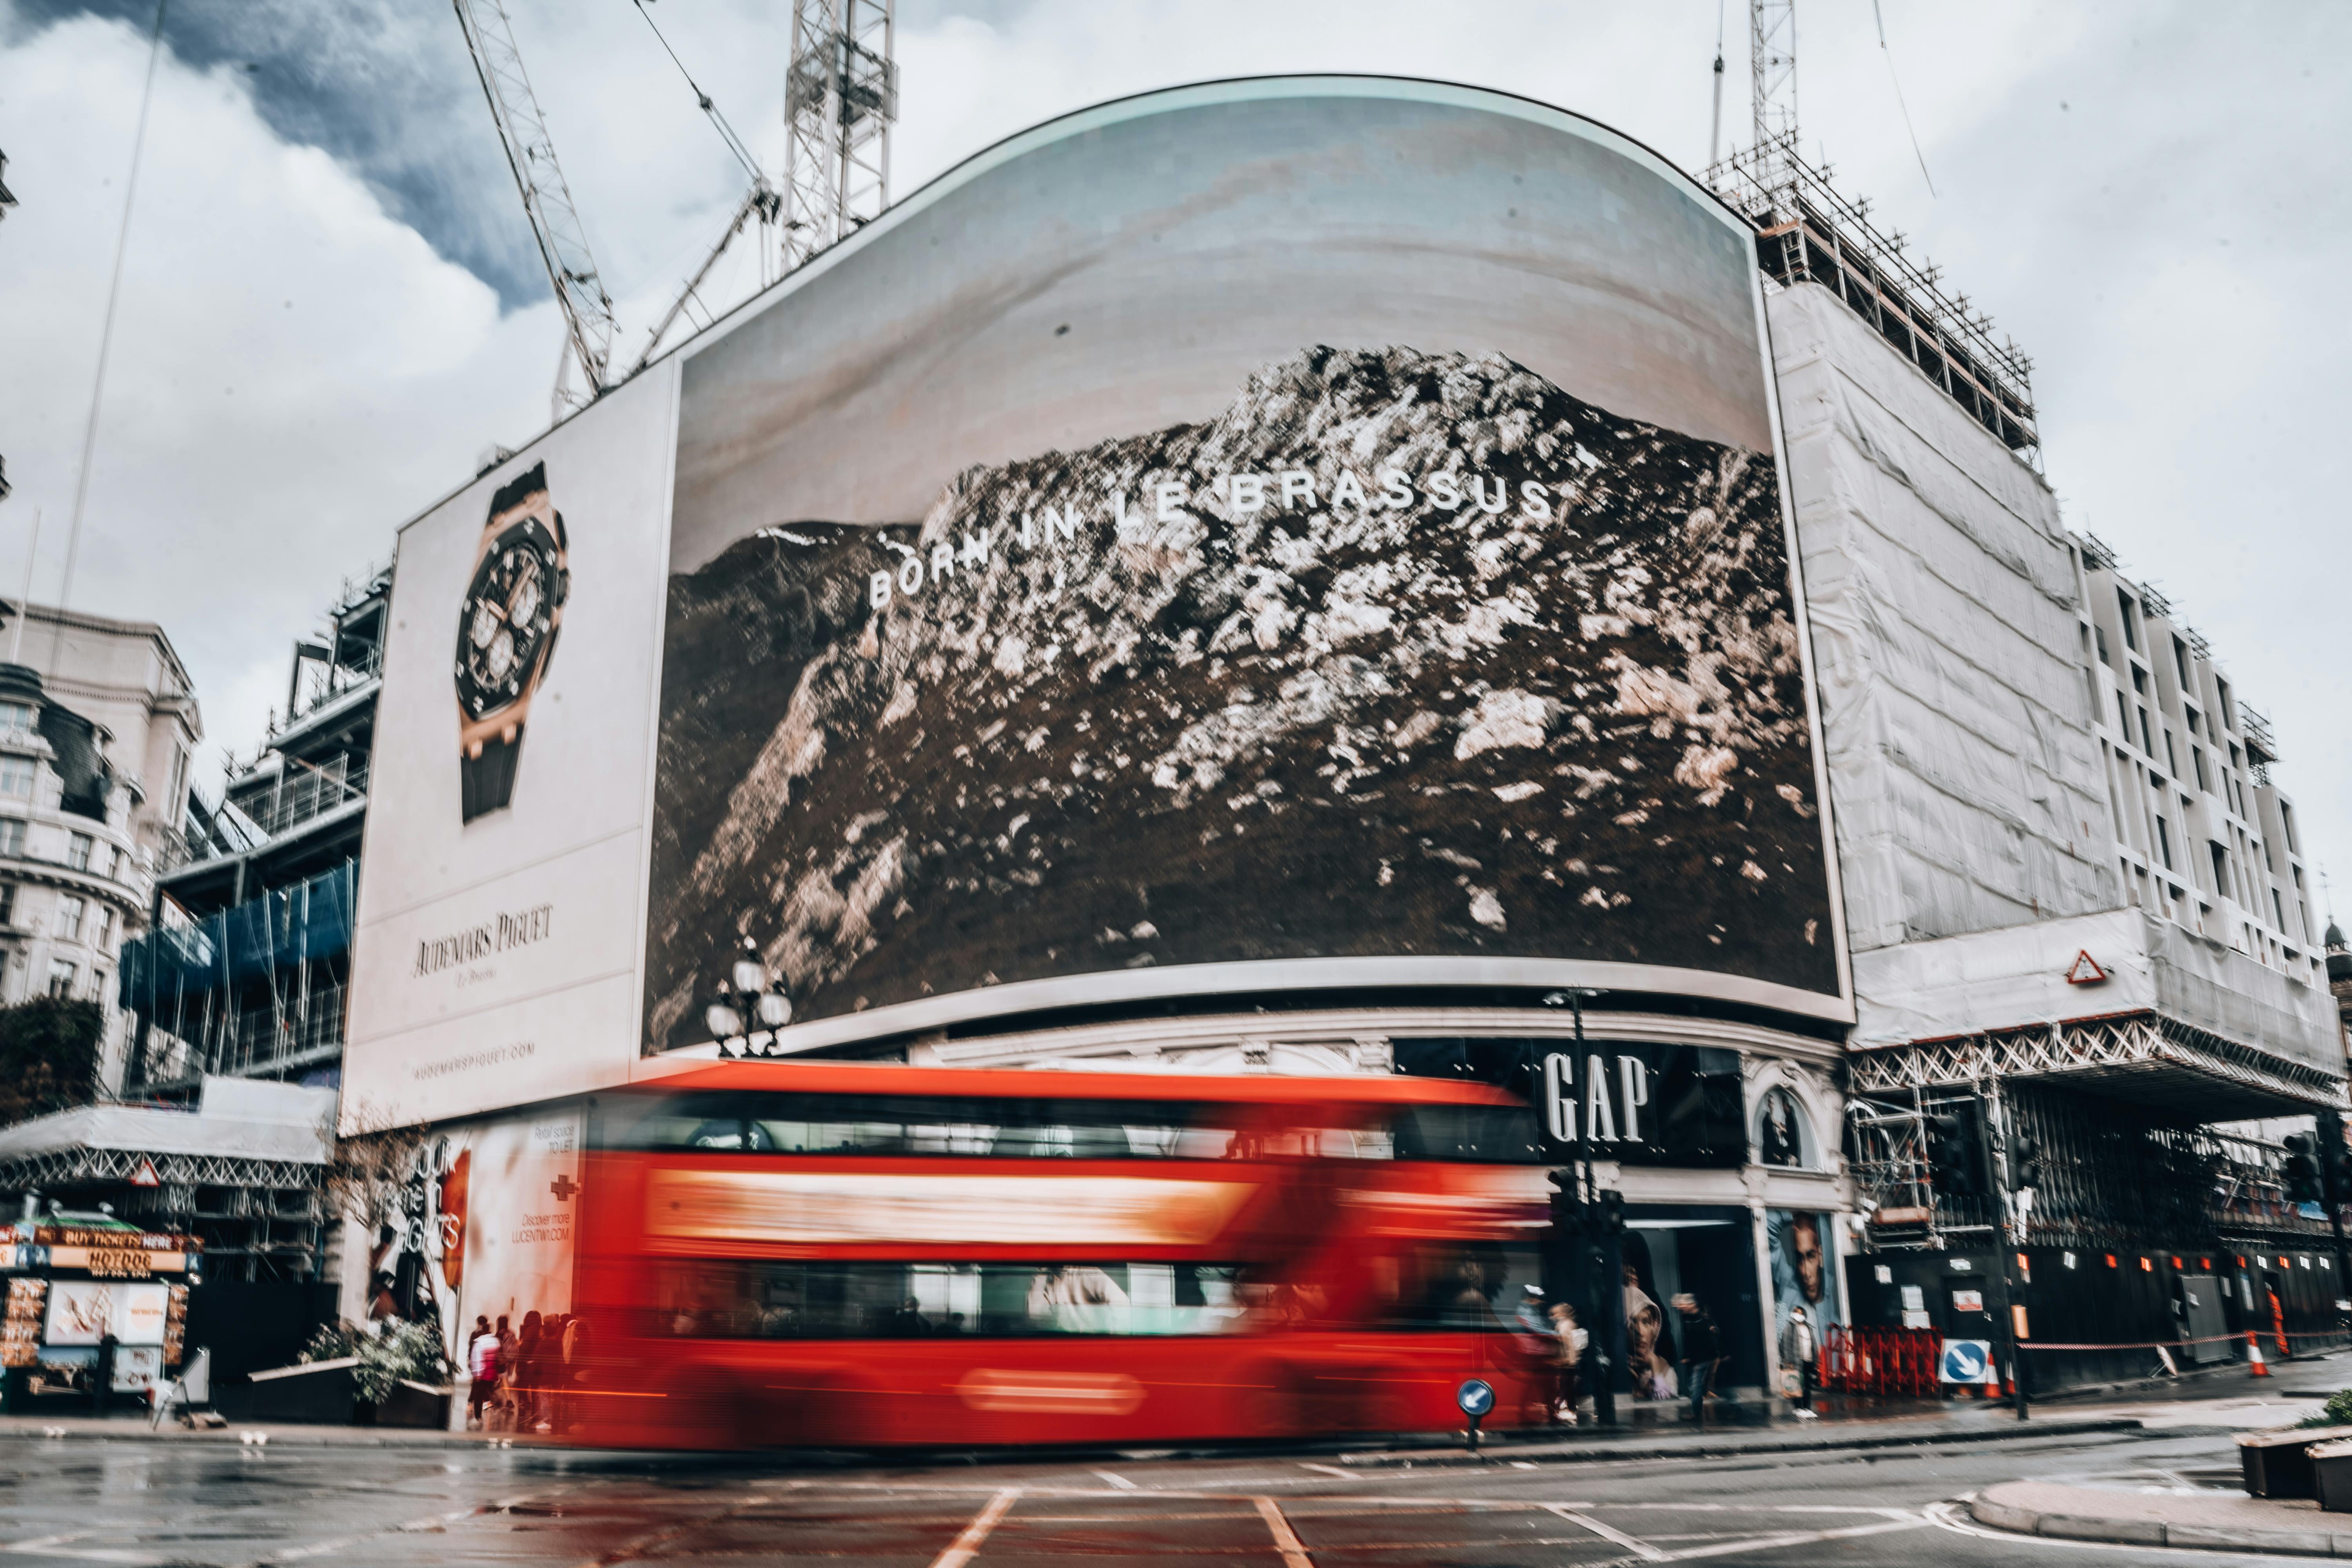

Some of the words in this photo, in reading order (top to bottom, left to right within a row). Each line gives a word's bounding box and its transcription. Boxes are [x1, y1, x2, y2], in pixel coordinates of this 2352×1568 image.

[870, 528, 988, 610] BORN
[1022, 503, 1074, 550] IN
[1115, 482, 1186, 528] LE
[1230, 470, 1551, 519] BRASSUS
[412, 922, 492, 978] AUDEMARS
[497, 904, 553, 952] PIGUET
[413, 1040, 535, 1081] AUDEMARSPIGUET.COM
[1544, 1053, 1647, 1142] GAP
[534, 1126, 552, 1140] Retail
[553, 1125, 574, 1138] space
[549, 1141, 559, 1154] TO
[560, 1139, 574, 1153] LET
[522, 1213, 551, 1227] Discover
[552, 1214, 570, 1224] more
[66, 1230, 91, 1246] BUY
[94, 1232, 141, 1249] TICKETS
[143, 1234, 172, 1250] HERE
